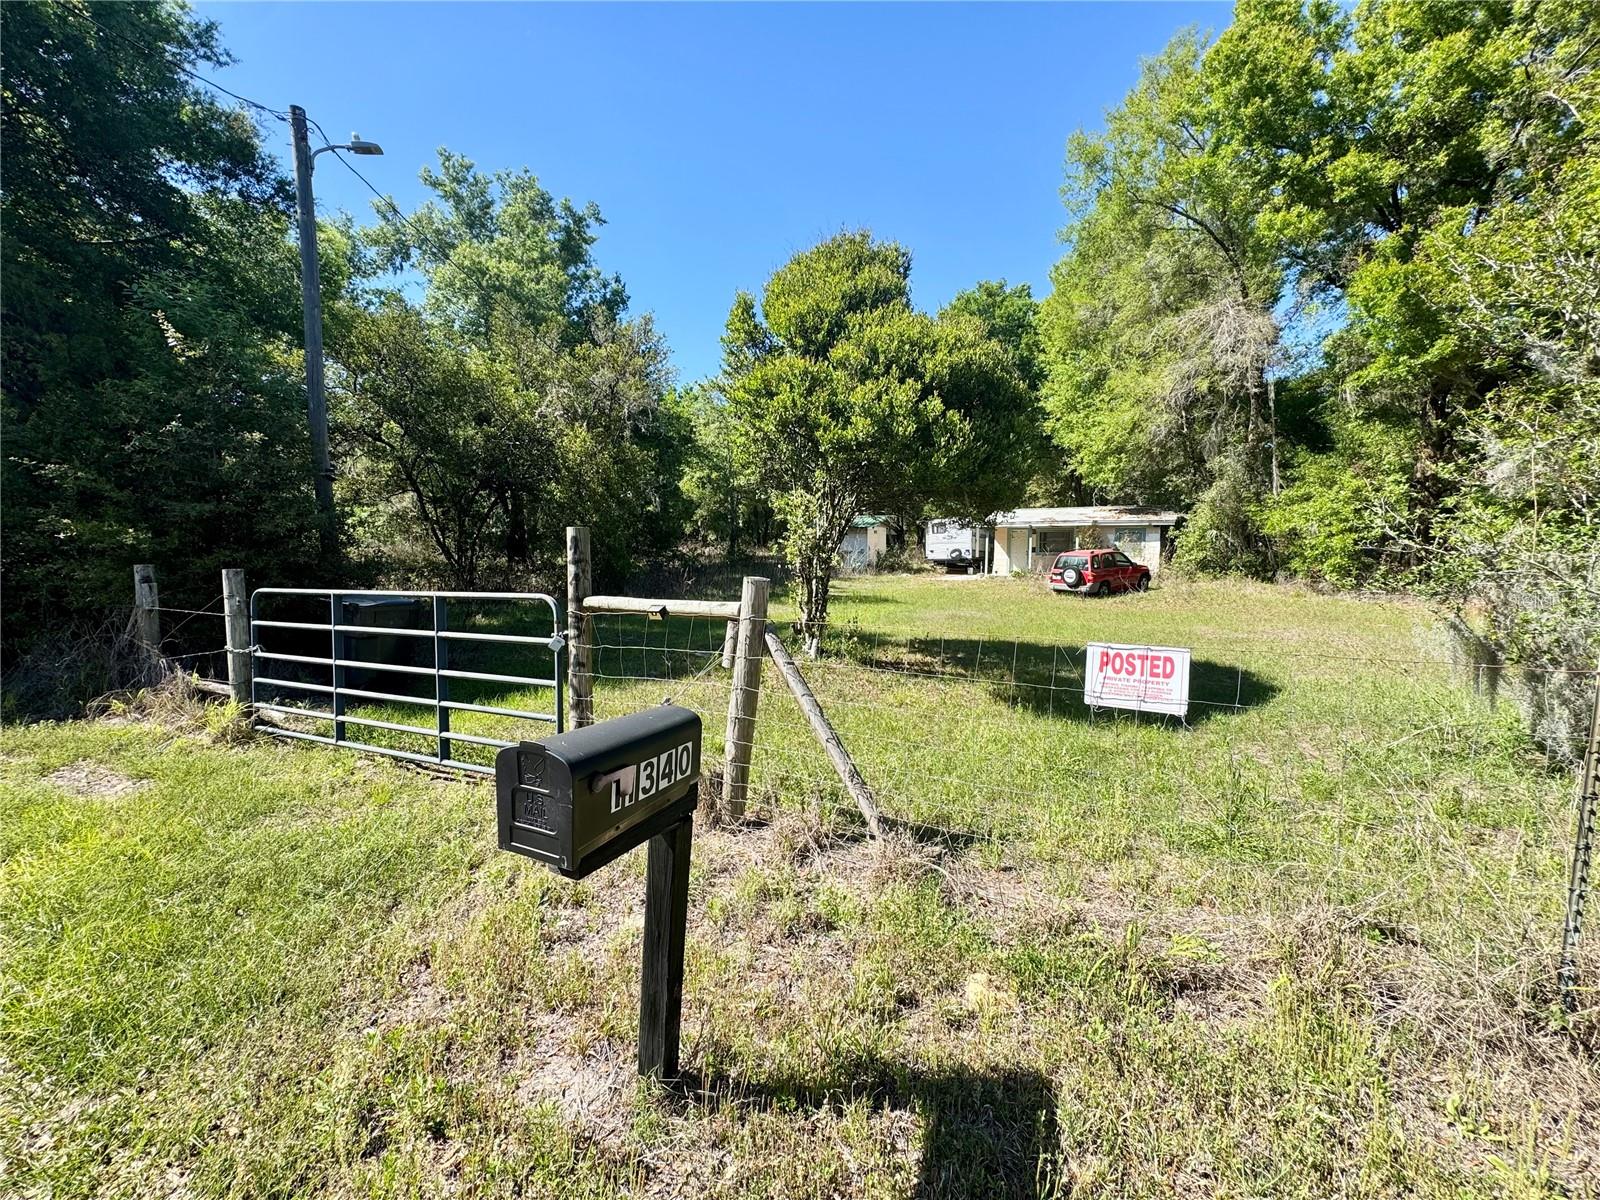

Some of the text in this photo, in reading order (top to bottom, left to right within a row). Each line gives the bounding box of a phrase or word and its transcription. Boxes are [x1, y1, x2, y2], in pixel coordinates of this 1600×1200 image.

[1099, 651, 1175, 679] POSTED
[1103, 676, 1131, 684] PRIVATE
[1133, 678, 1170, 687] PROPERTY
[524, 802, 548, 819] MAIL
